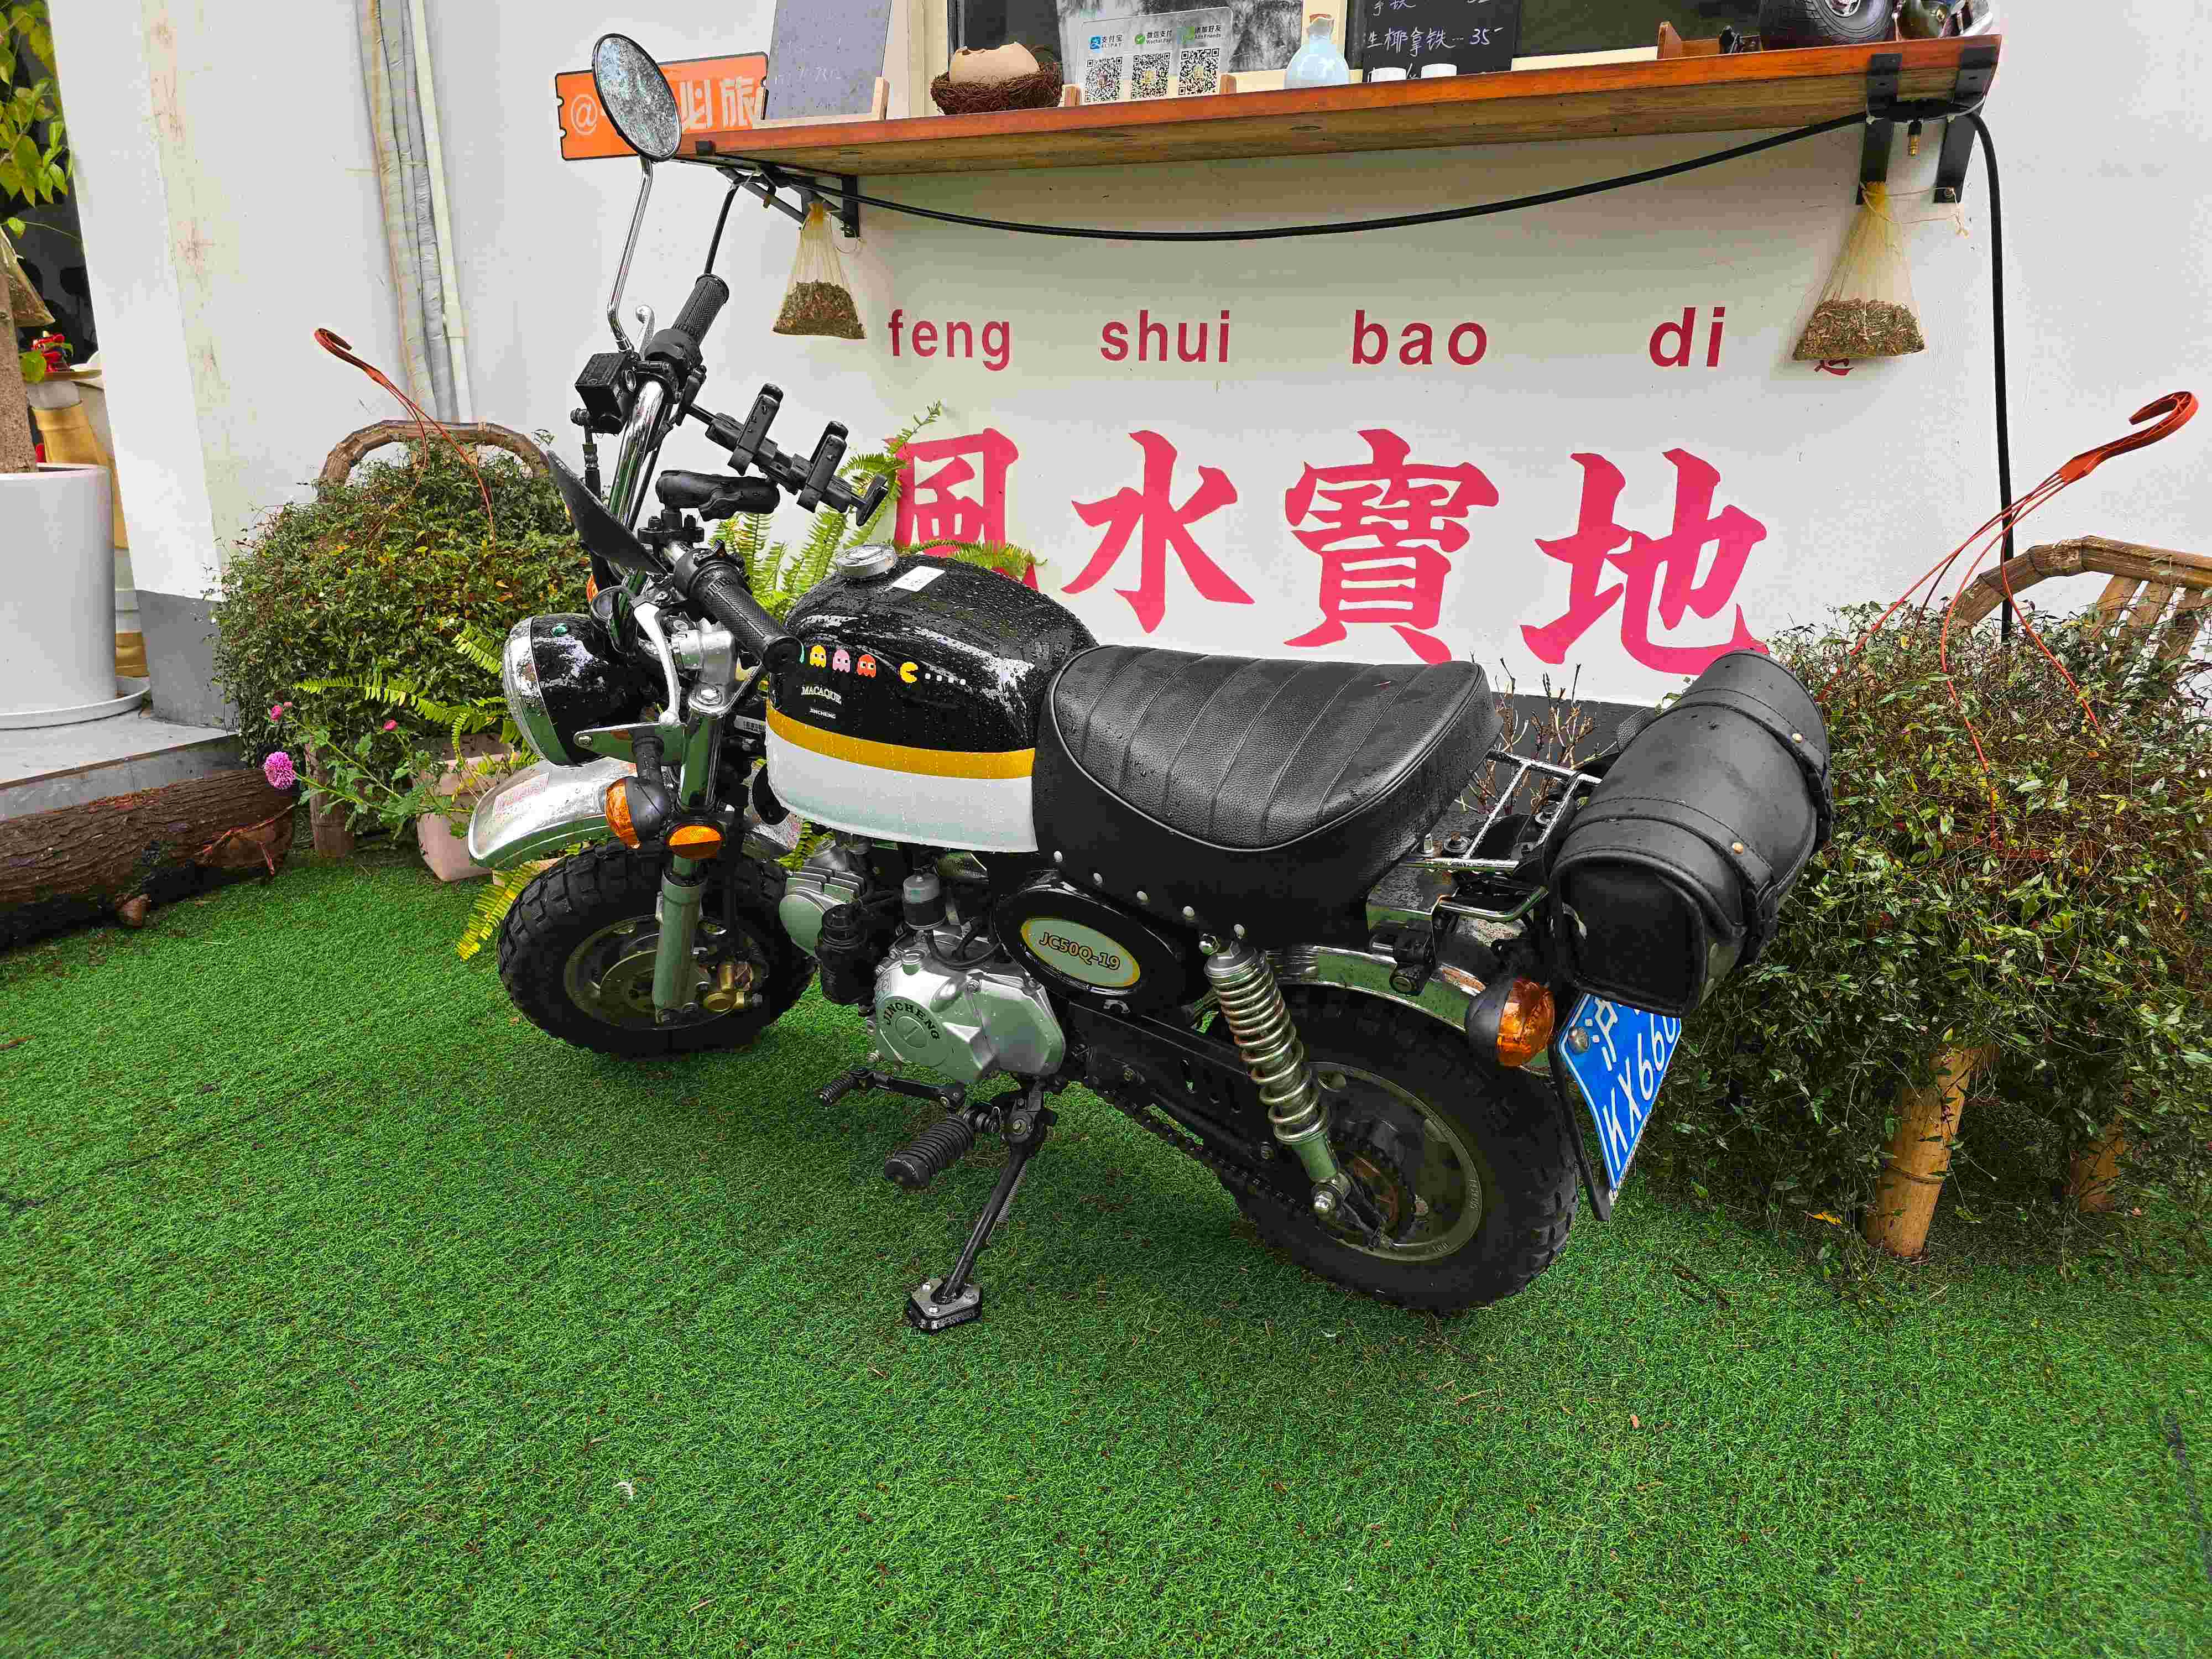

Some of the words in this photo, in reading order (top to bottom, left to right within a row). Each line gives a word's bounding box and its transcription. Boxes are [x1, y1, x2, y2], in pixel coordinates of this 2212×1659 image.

[1102, 35, 1123, 43] 支付宝
[1146, 30, 1172, 39] 微信支付
[1366, 27, 1456, 57] 生椰拿铁
[888, 309, 1010, 372] feng
[1100, 310, 1230, 363] shui
[1352, 309, 1488, 366] bao
[1648, 306, 1726, 368] di
[885, 427, 1771, 677] 風水寶地
[801, 685, 842, 705] MACAQUE
[809, 707, 836, 719] JINCHENG
[1039, 931, 1121, 971] JC50Q-19
[884, 1001, 941, 1040] JINCHENG
